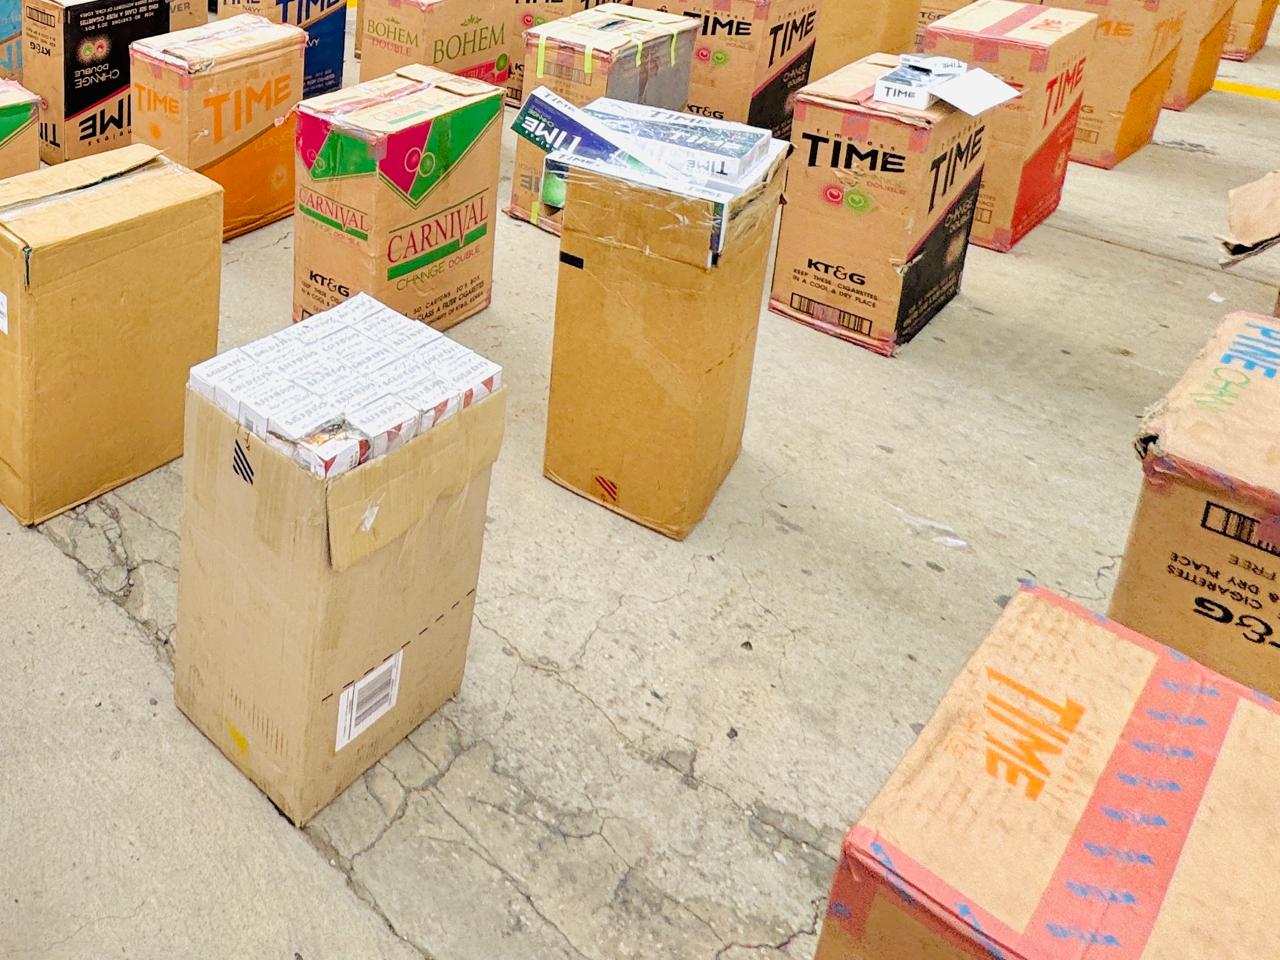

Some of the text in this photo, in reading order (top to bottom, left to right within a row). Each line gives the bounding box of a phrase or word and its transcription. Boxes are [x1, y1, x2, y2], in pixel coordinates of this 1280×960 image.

[80, 16, 105, 26] CIGARETTES
[125, 8, 137, 16] CLASS
[242, 4, 261, 13] NAVY
[367, 19, 418, 48] BOHEM
[683, 11, 752, 36] TIME
[371, 37, 411, 56] DOUBLE
[432, 23, 505, 65] BOHEM
[768, 10, 816, 68] TIME
[74, 63, 109, 78] DOUBLE
[74, 68, 120, 89] CHANGE
[134, 82, 180, 113] TIME
[884, 86, 916, 98] TIME
[1043, 57, 1086, 128] TIME
[204, 74, 292, 144] TIME
[650, 110, 713, 125] TIME
[687, 103, 724, 120] KT&G
[521, 116, 583, 153] TIME
[802, 132, 906, 173] TIME
[687, 159, 728, 176] TIME
[928, 125, 985, 214] TIME
[299, 188, 369, 232] CARNIVAL
[387, 196, 488, 264] CARNIVAL
[396, 244, 481, 291] CHANGE DOUBLE
[807, 258, 866, 286] KT&G
[309, 271, 350, 298] KT&G
[458, 281, 484, 301] CIGARETTES
[809, 281, 876, 309] COOL DRY PLACE
[814, 274, 832, 286] THESE
[837, 282, 878, 301] CIGARETTES
[425, 291, 451, 309] CARTONS
[1167, 563, 1263, 610] CIGARETTES
[1170, 551, 1260, 595] PLACE DRY
[984, 667, 1087, 801] TIME
